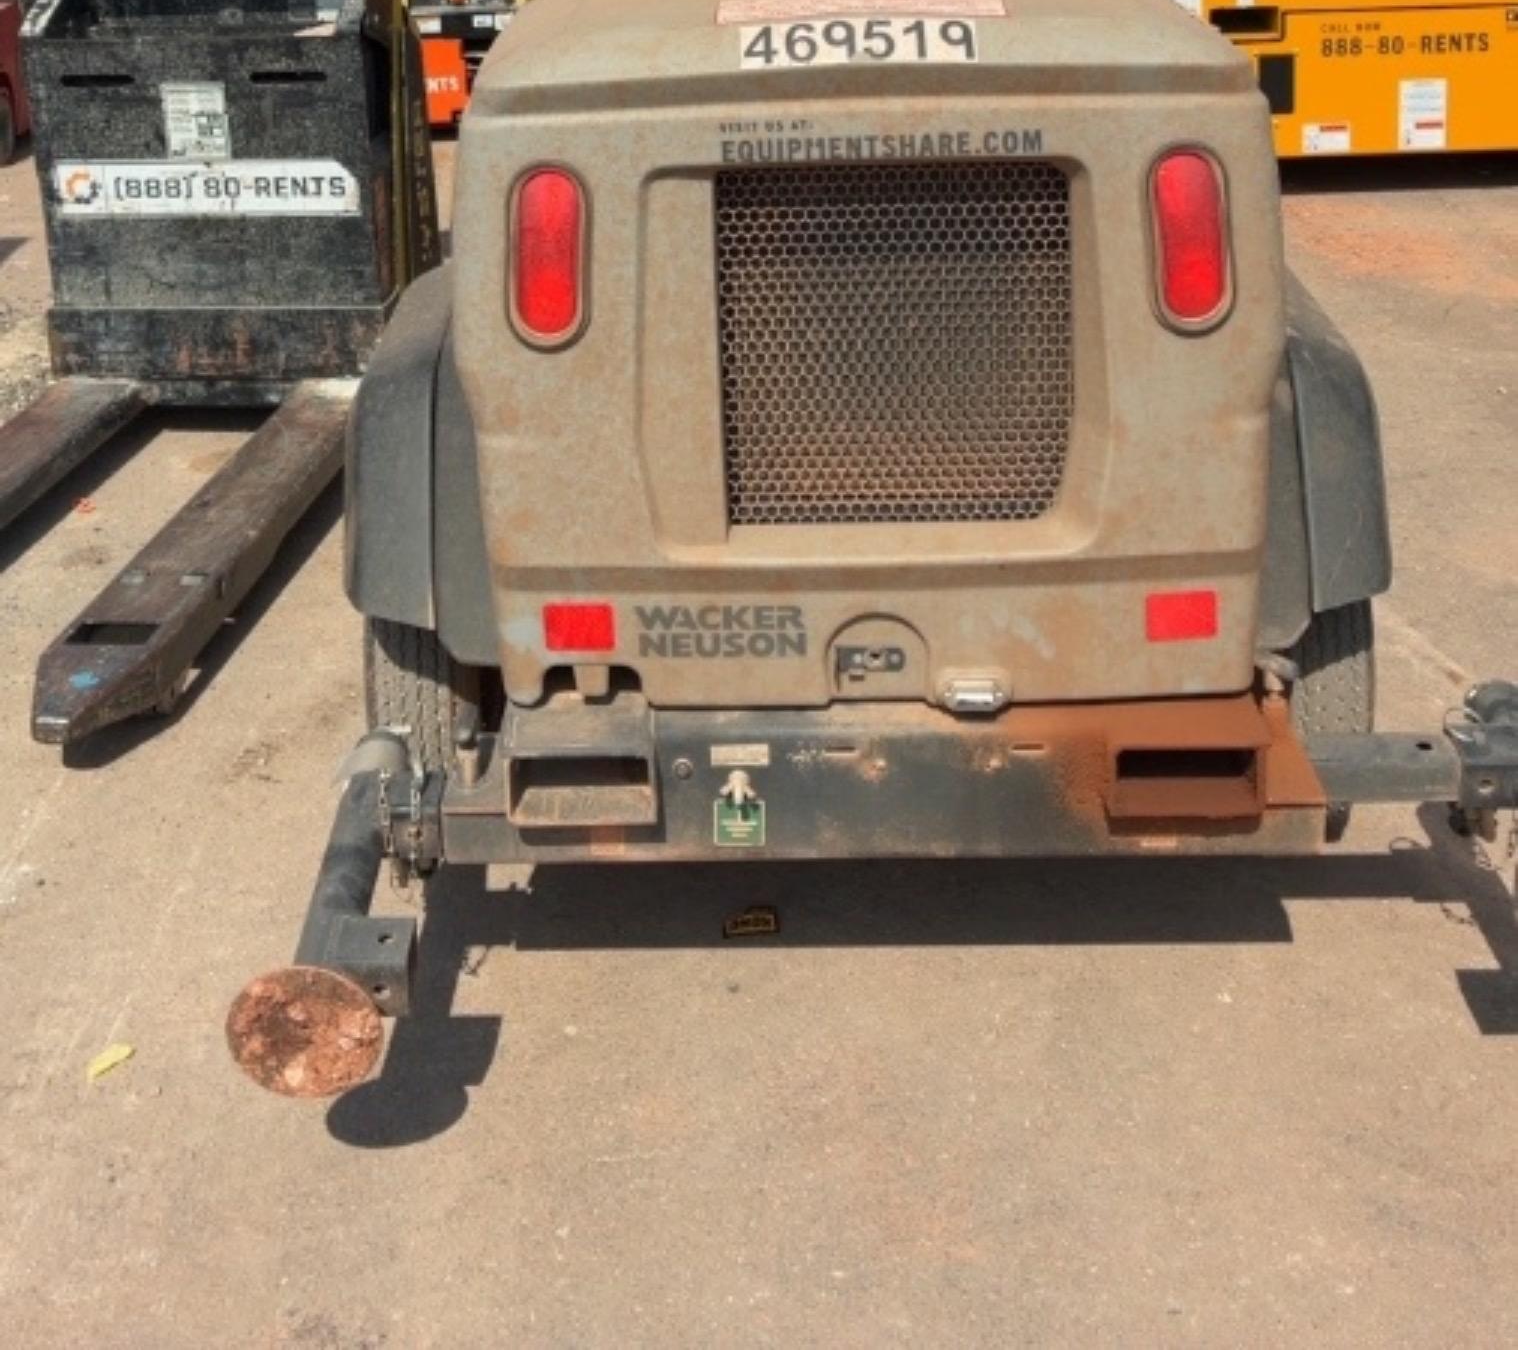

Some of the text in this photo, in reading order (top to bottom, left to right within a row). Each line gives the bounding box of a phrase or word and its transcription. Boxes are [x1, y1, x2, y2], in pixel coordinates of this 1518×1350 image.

[743, 19, 976, 64] 469519
[721, 129, 1043, 164] EQUIPMENTSHARE.COM
[113, 175, 347, 201] (888) 80-RENTS
[634, 604, 804, 631] WACKER
[638, 632, 807, 658] NEUSON
